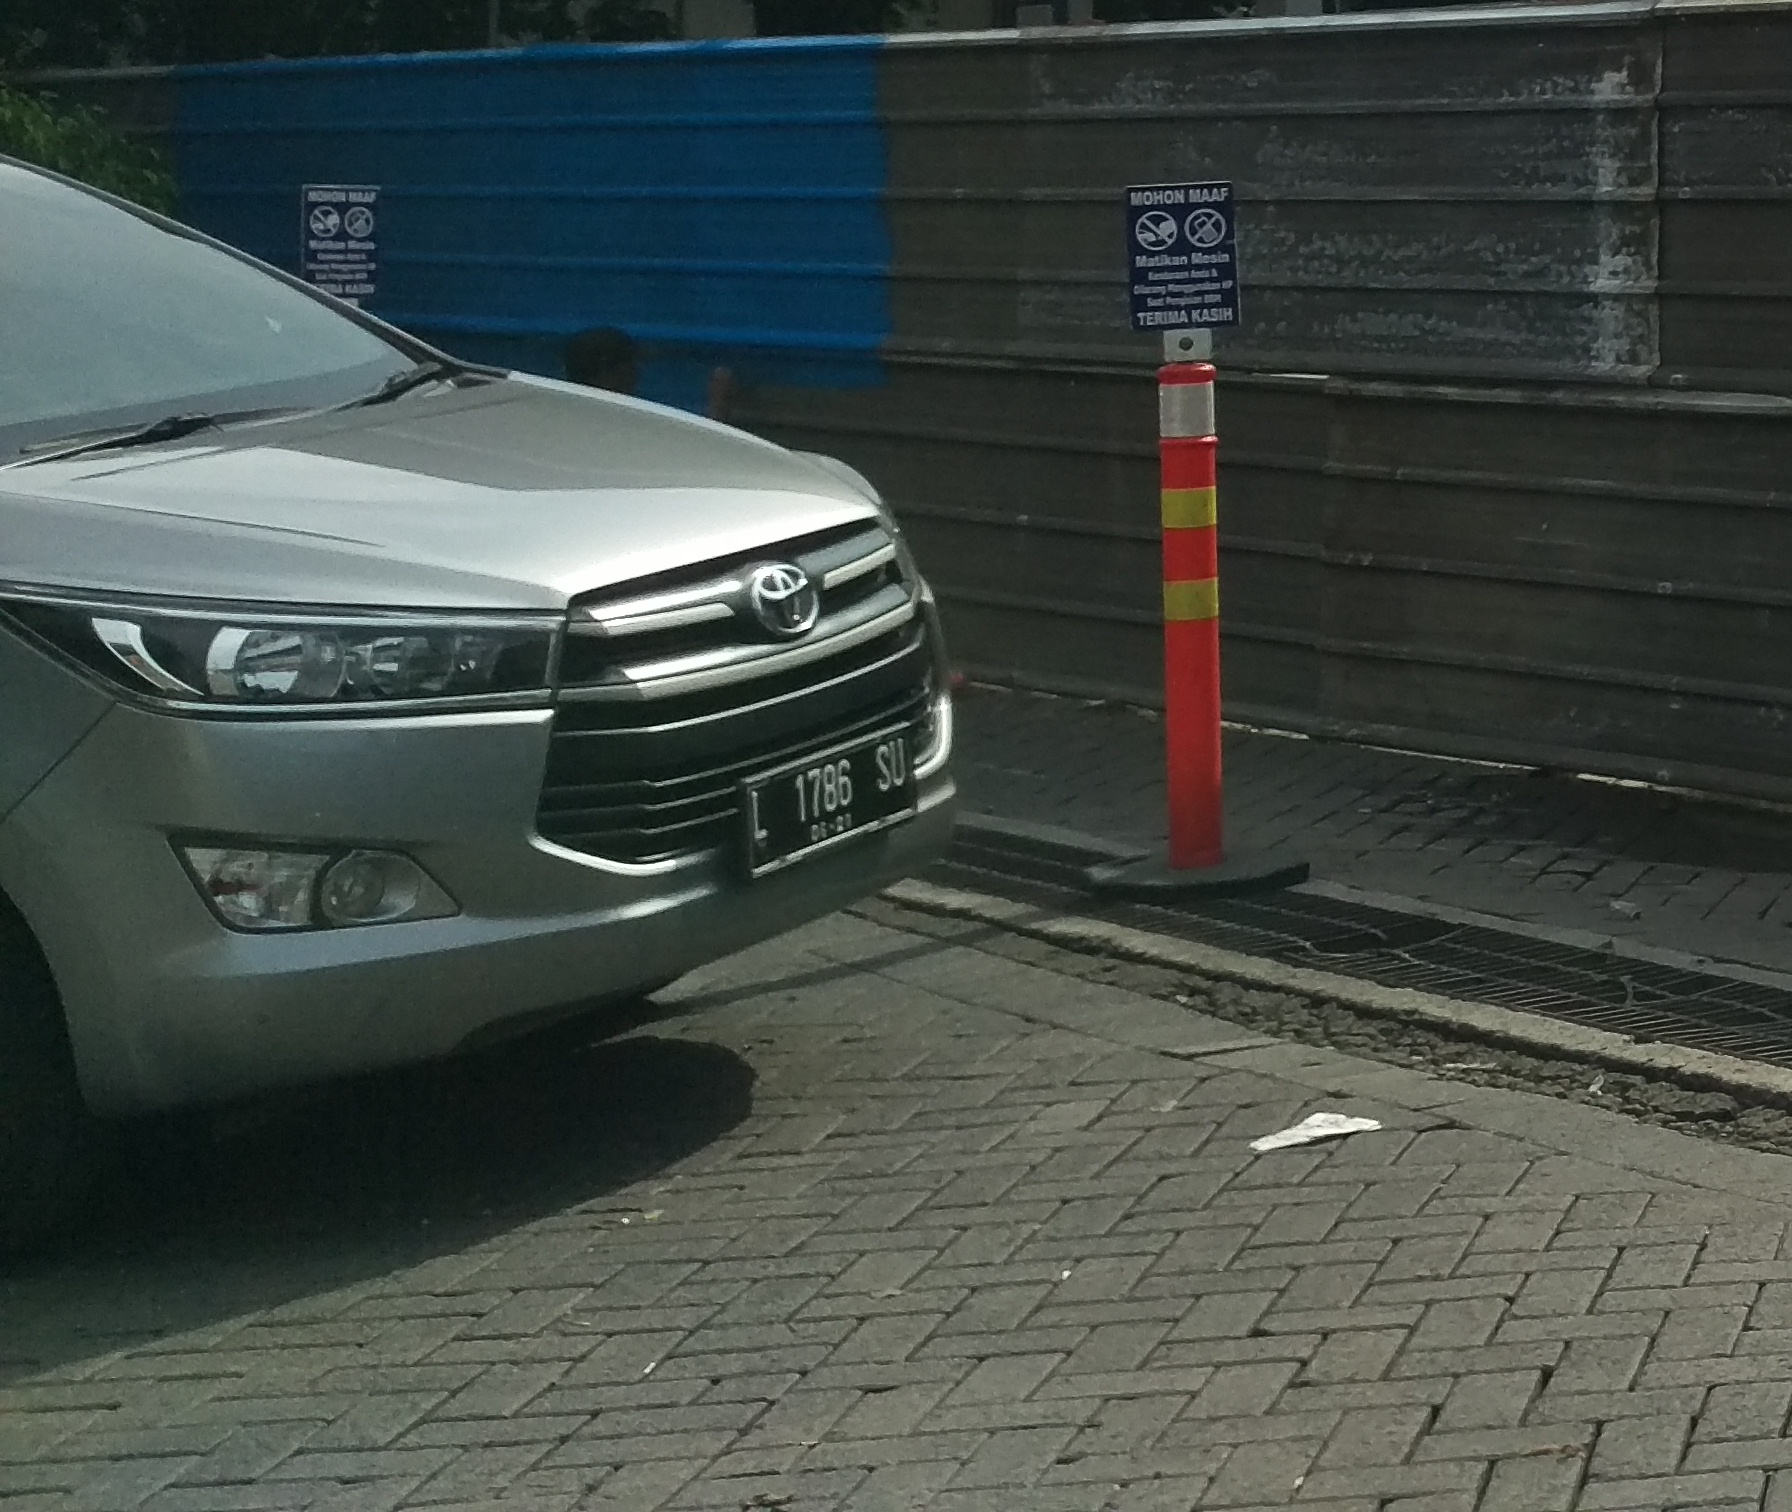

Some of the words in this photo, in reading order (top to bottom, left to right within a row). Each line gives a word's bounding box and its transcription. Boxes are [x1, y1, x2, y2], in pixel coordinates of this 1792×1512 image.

[1130, 189, 1185, 206] MOHON
[1189, 188, 1229, 203] MAAF
[1137, 309, 1188, 326] TERIMA
[1191, 307, 1233, 323] KASIH
[751, 791, 769, 839] L
[795, 758, 853, 823] 1786
[875, 738, 906, 792] SU
